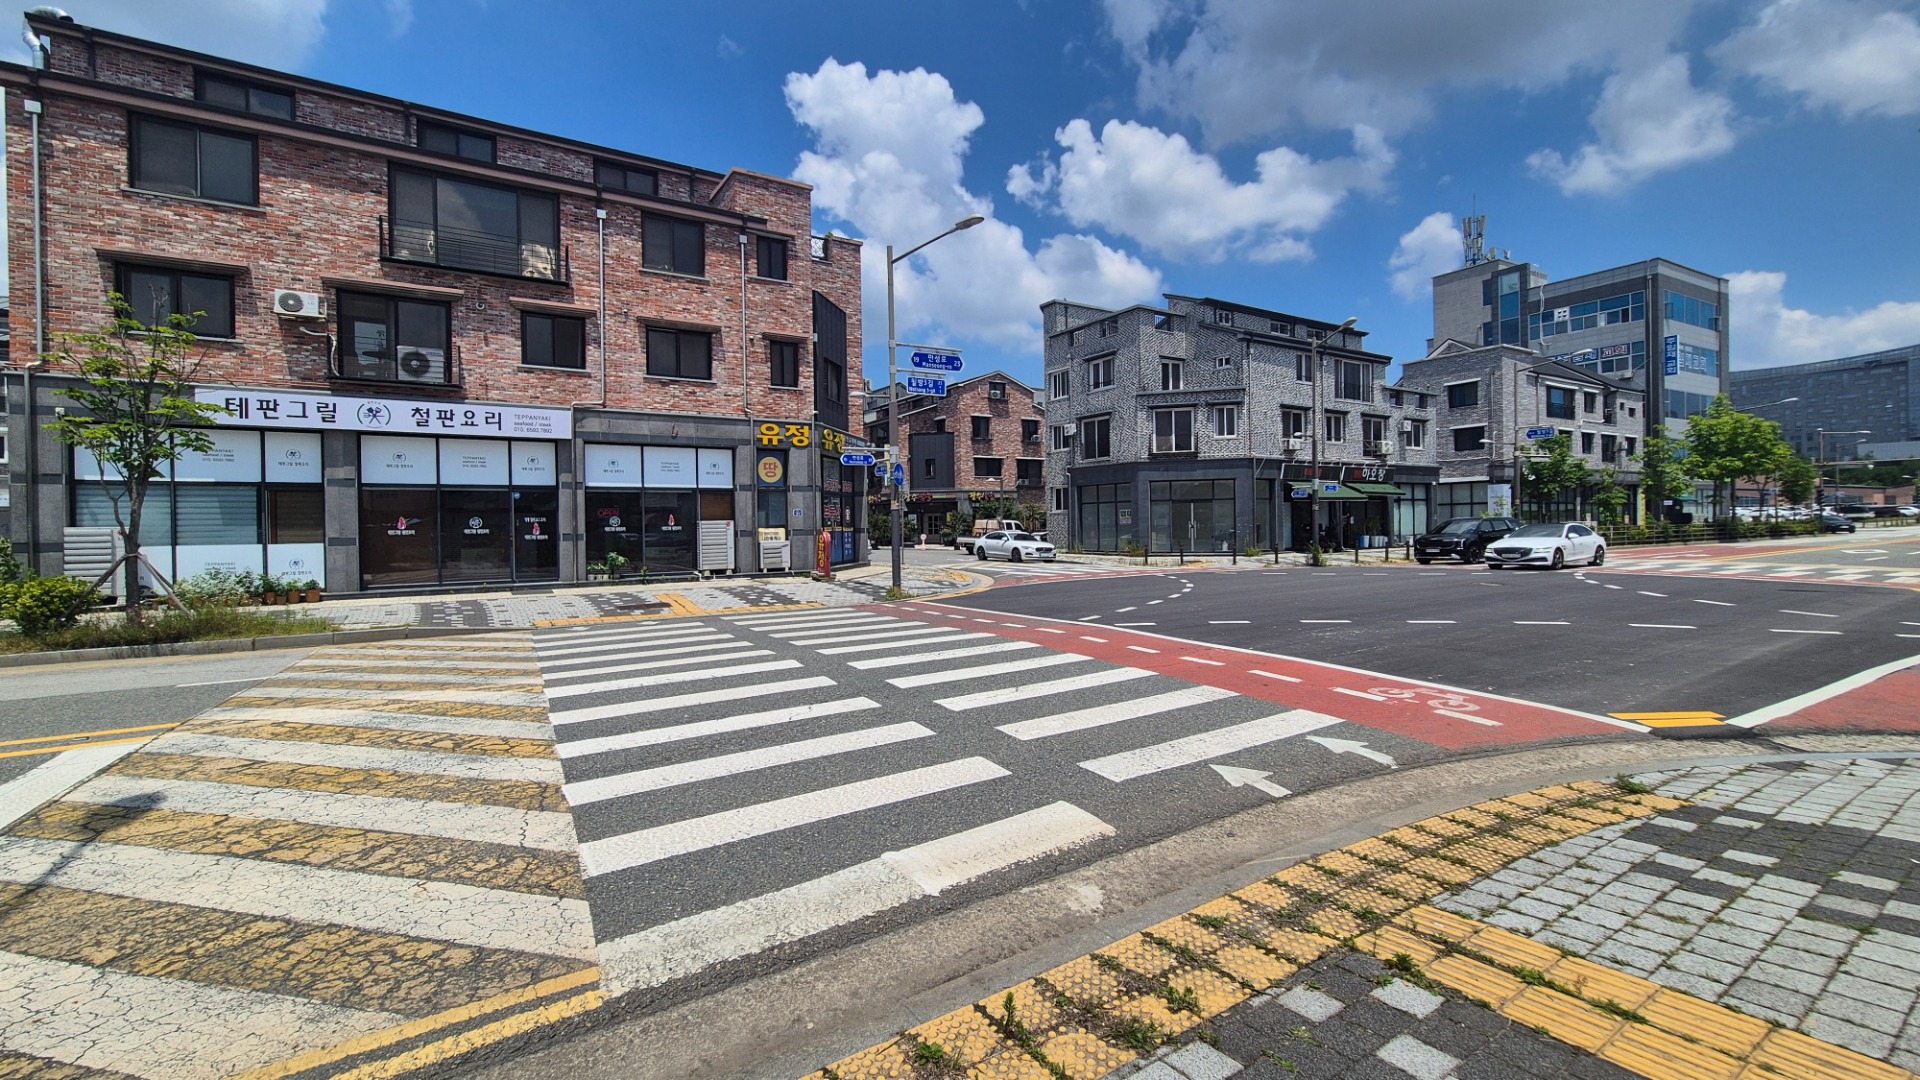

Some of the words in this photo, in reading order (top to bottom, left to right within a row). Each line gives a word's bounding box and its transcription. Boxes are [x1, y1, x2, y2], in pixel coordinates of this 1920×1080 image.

[927, 354, 948, 363] 만성로
[225, 397, 337, 424] 테판그릴
[411, 407, 502, 431] 철판요리
[757, 423, 810, 447] 유정
[763, 461, 779, 478] 땅
[818, 534, 826, 568] 유정
